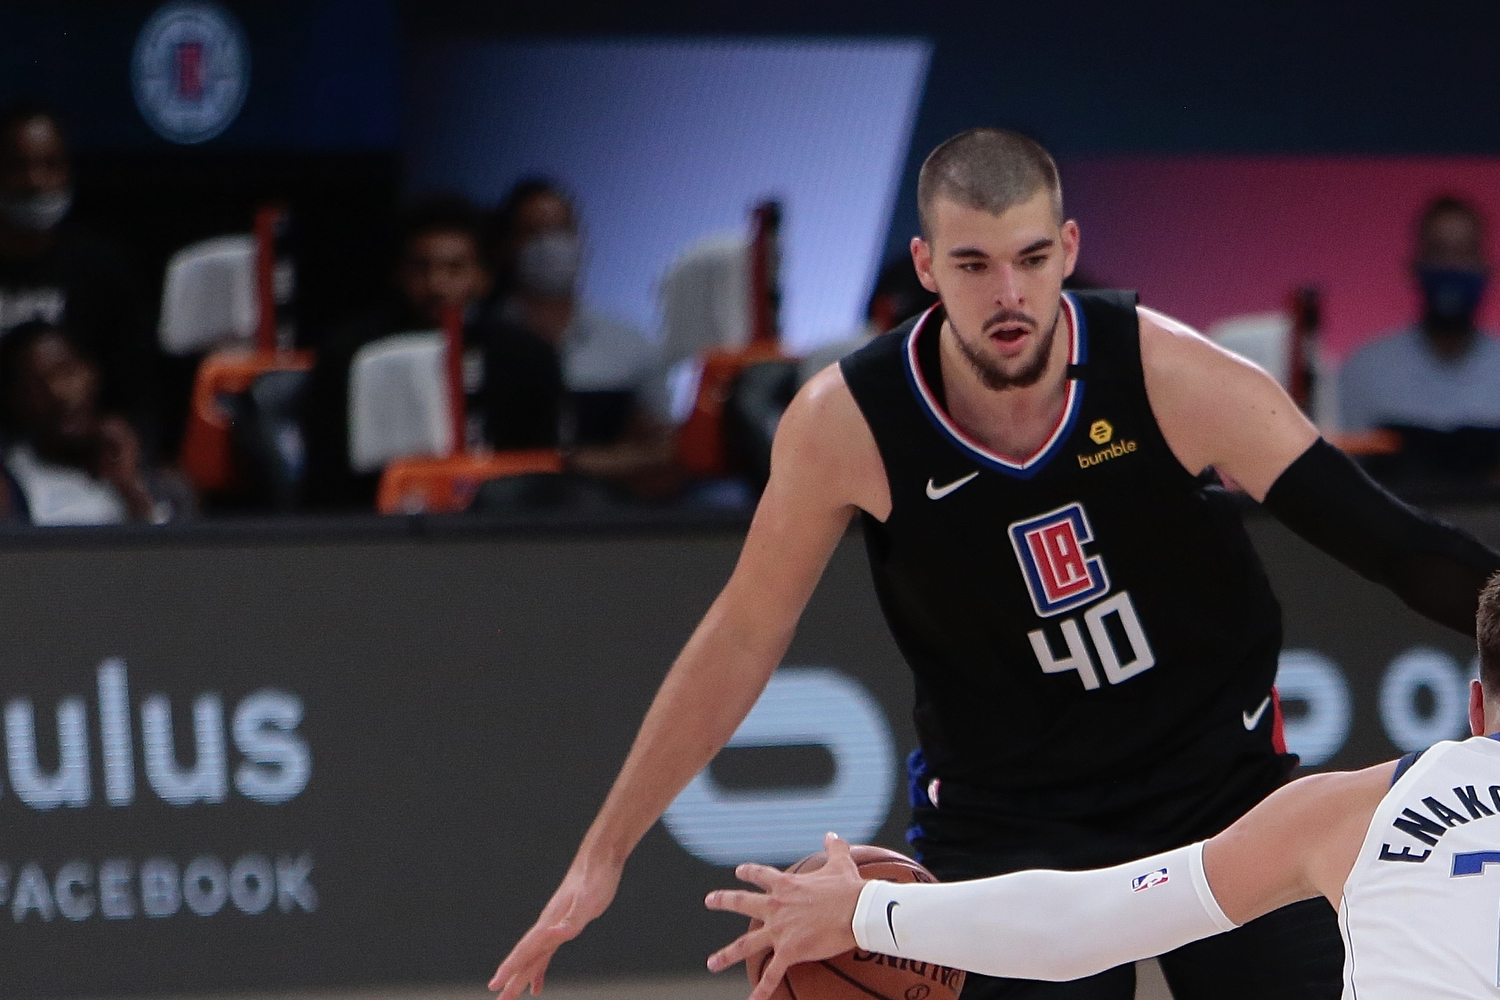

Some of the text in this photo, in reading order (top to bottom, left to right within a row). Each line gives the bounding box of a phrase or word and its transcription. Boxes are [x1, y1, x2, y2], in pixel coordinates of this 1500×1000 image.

[1077, 440, 1136, 469] bumble
[1028, 591, 1155, 690] 40
[4, 655, 312, 811] ulus
